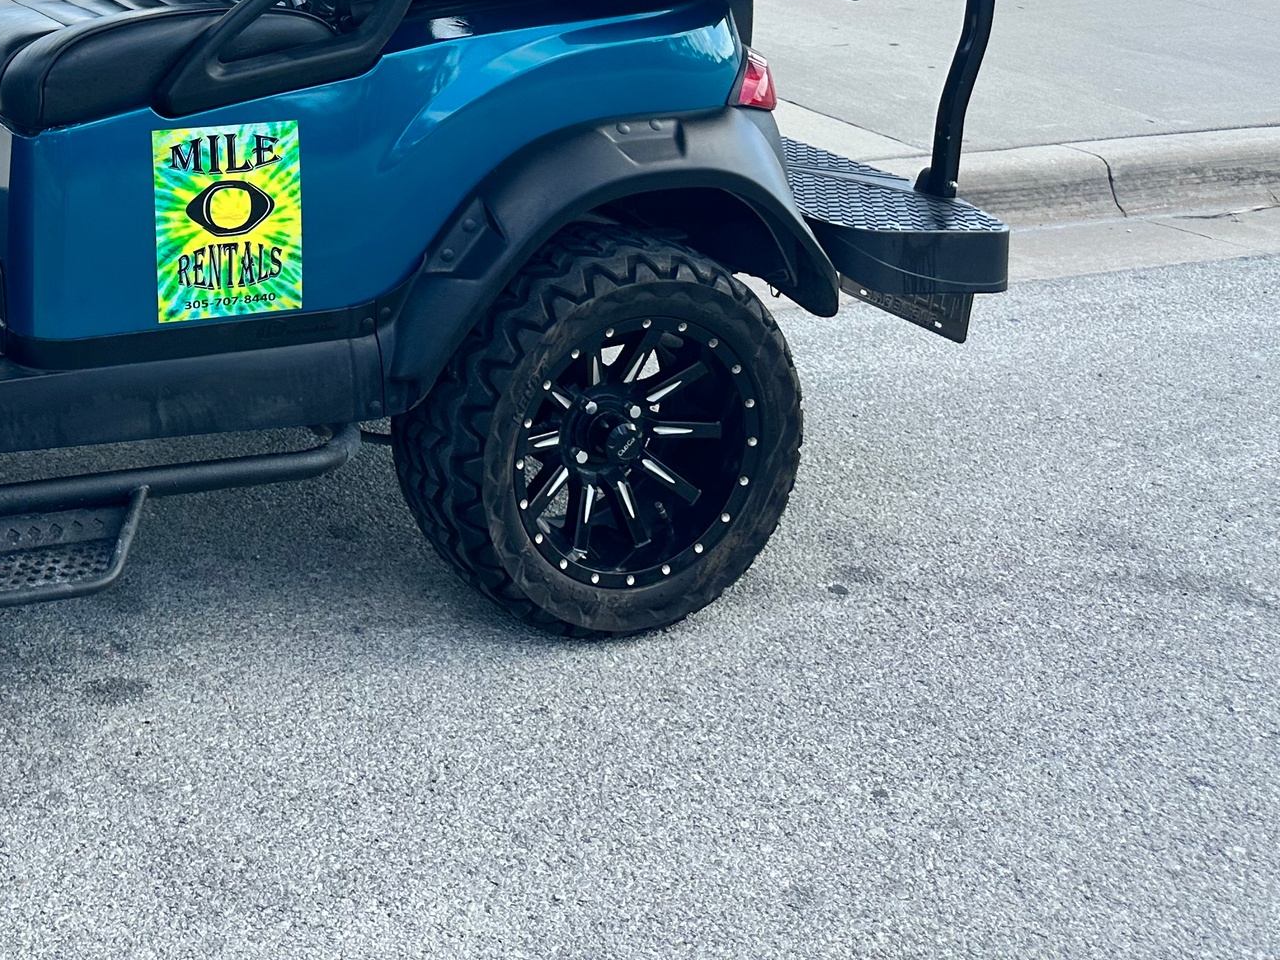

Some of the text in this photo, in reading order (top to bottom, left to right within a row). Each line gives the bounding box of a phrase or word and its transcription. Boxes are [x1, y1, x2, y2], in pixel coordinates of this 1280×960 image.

[169, 133, 283, 175] MILE
[177, 241, 283, 290] RENTALS
[184, 292, 277, 310] 305-707-8440
